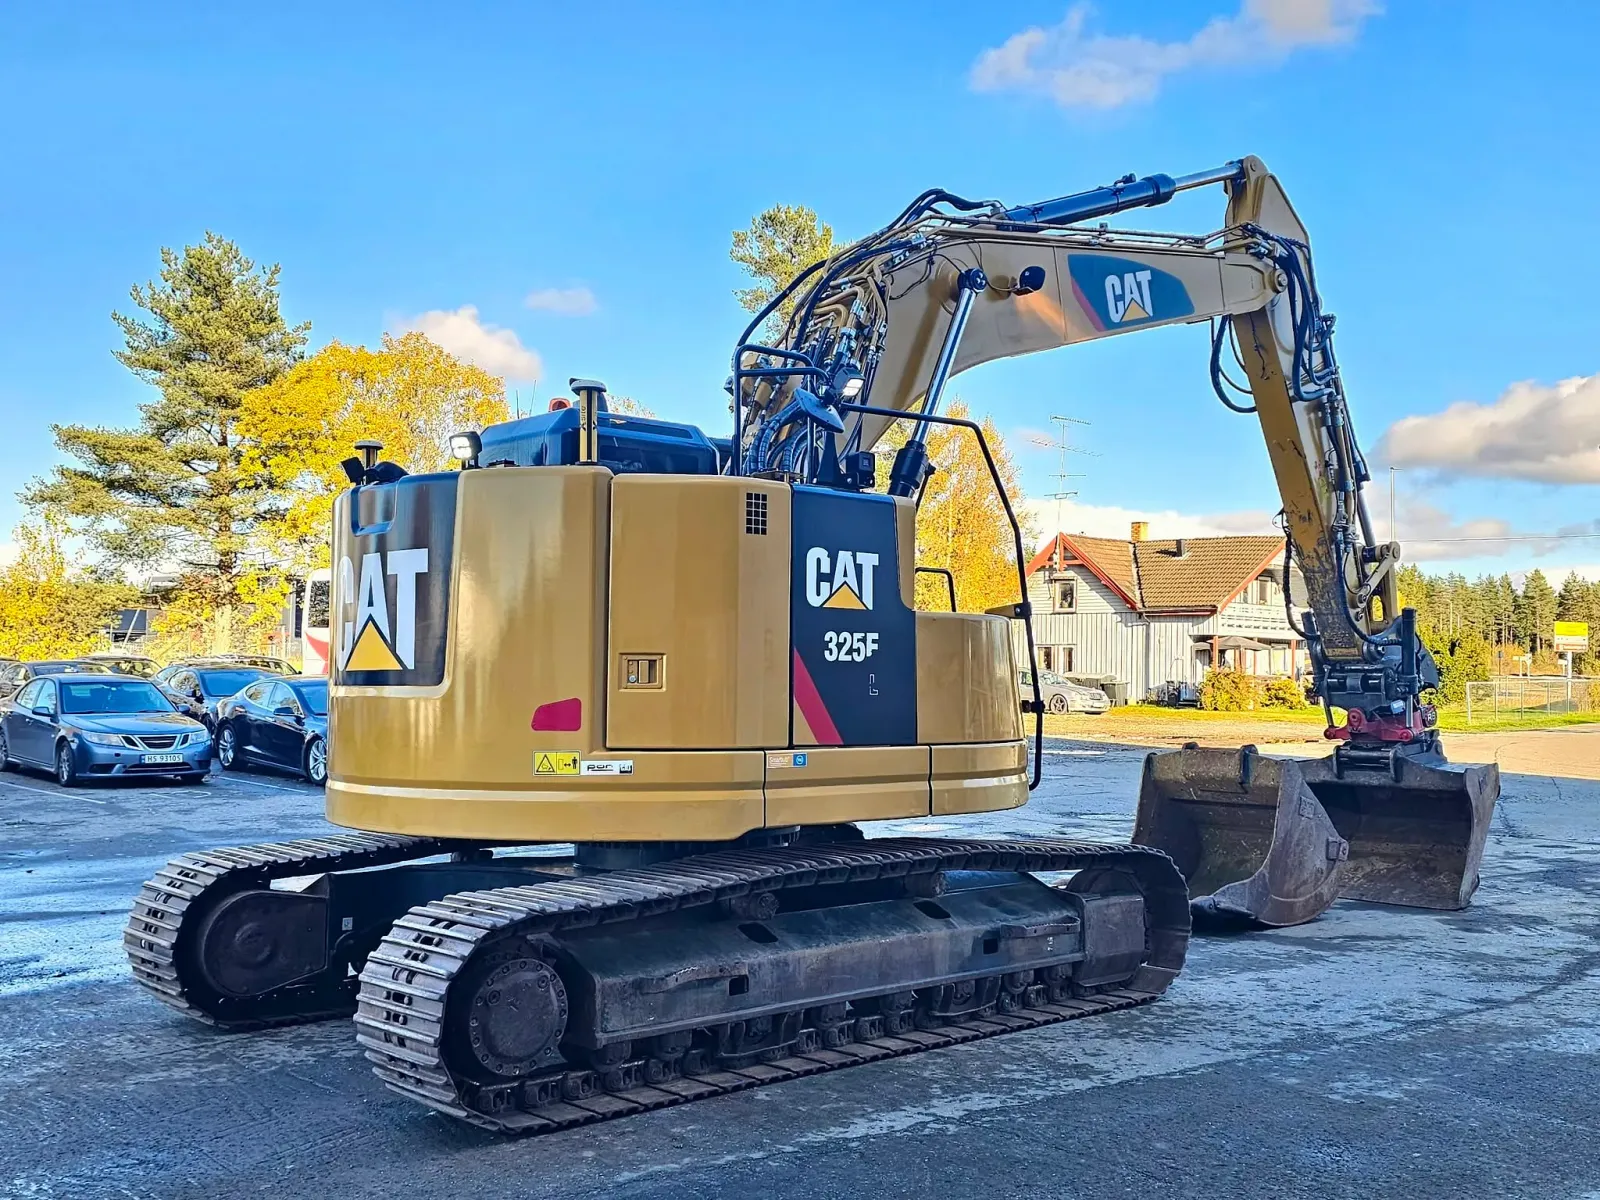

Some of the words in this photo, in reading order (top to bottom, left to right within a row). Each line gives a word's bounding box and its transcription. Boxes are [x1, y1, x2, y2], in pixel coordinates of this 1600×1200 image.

[1104, 269, 1154, 323] CAT
[805, 546, 880, 611] CAT
[337, 547, 429, 672] CAT
[823, 630, 880, 662] 325F
